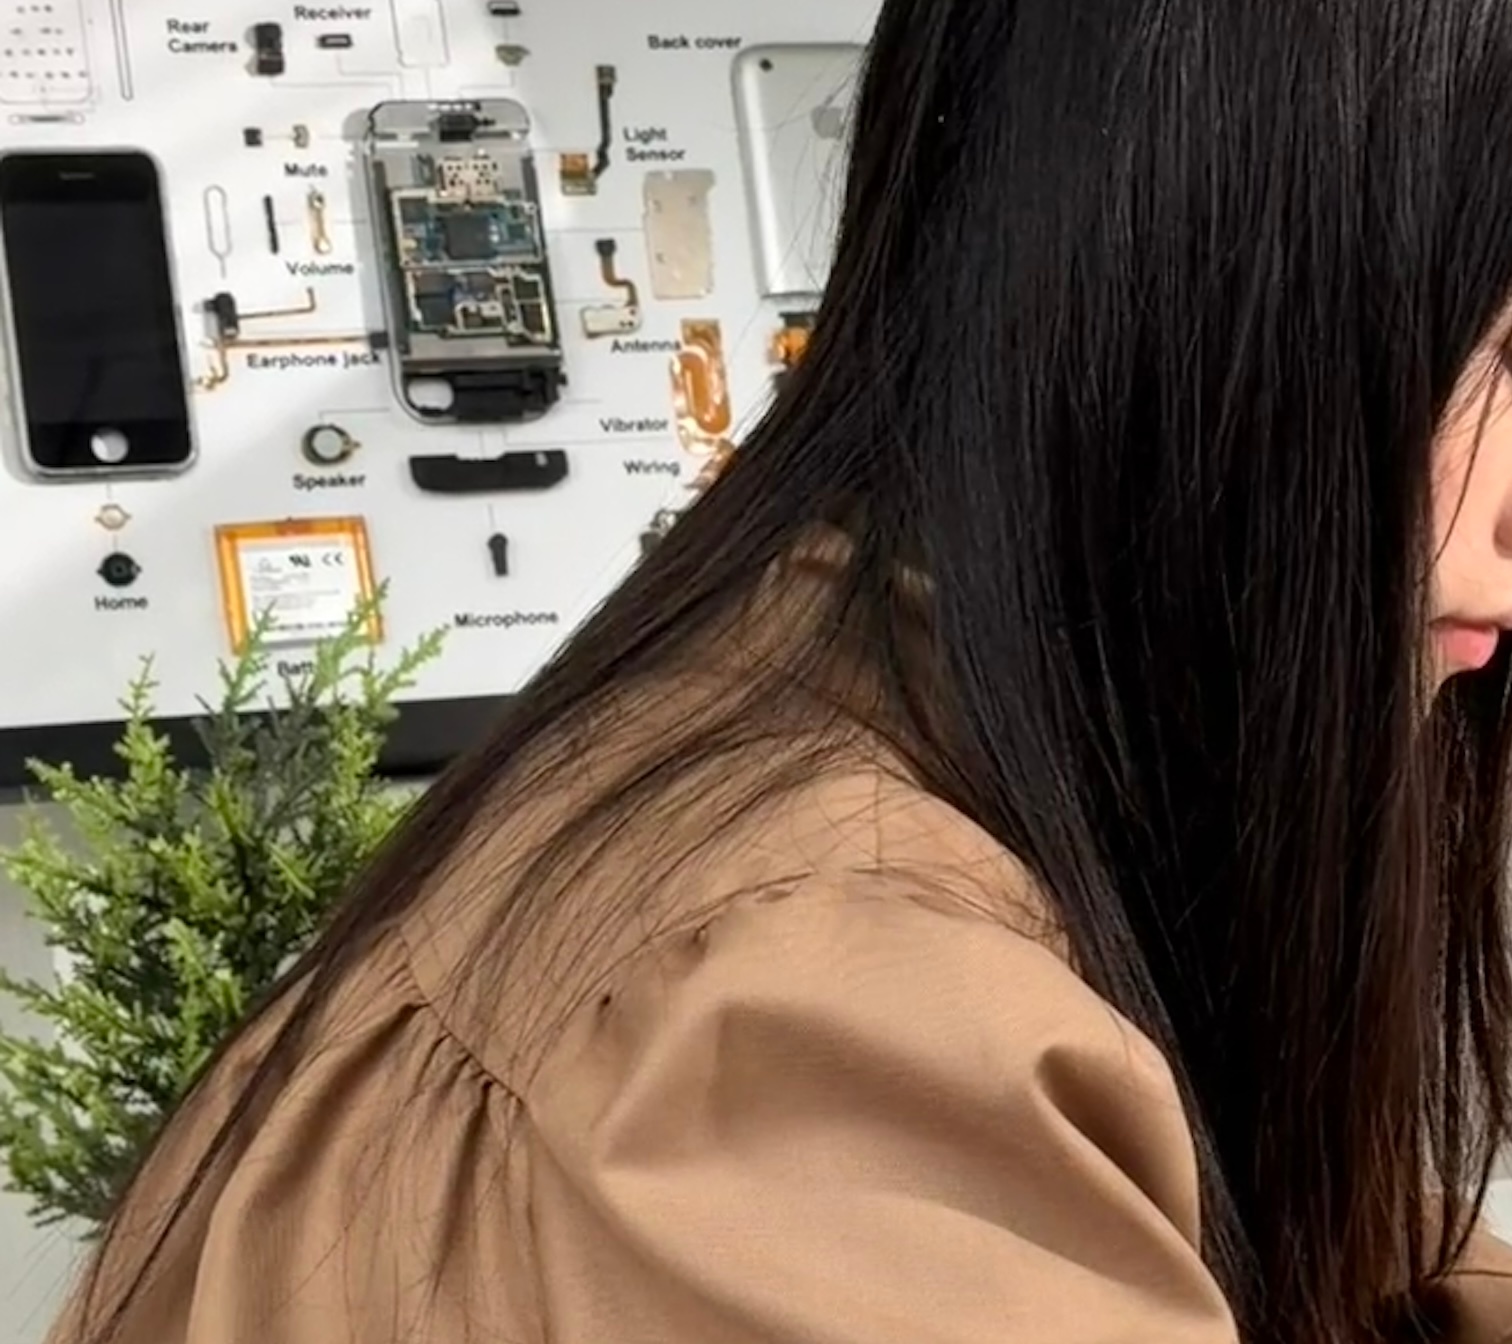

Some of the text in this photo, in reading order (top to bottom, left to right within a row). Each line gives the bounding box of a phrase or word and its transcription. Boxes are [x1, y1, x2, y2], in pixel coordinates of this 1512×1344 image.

[294, 6, 371, 20] Receiver
[167, 20, 209, 34] Rear
[168, 39, 238, 53] Camera
[648, 36, 742, 50] Back cover
[624, 127, 667, 143] Light
[626, 147, 685, 161] Sensor
[284, 164, 328, 177] Mute
[286, 262, 354, 276] Volume
[611, 339, 681, 353] Antenna
[247, 352, 382, 369] Earphone jack
[600, 418, 669, 432] Vibrator
[624, 460, 680, 477] Wiring
[293, 473, 366, 490] Speaker
[94, 595, 148, 610] Home
[454, 609, 558, 629] Microphone
